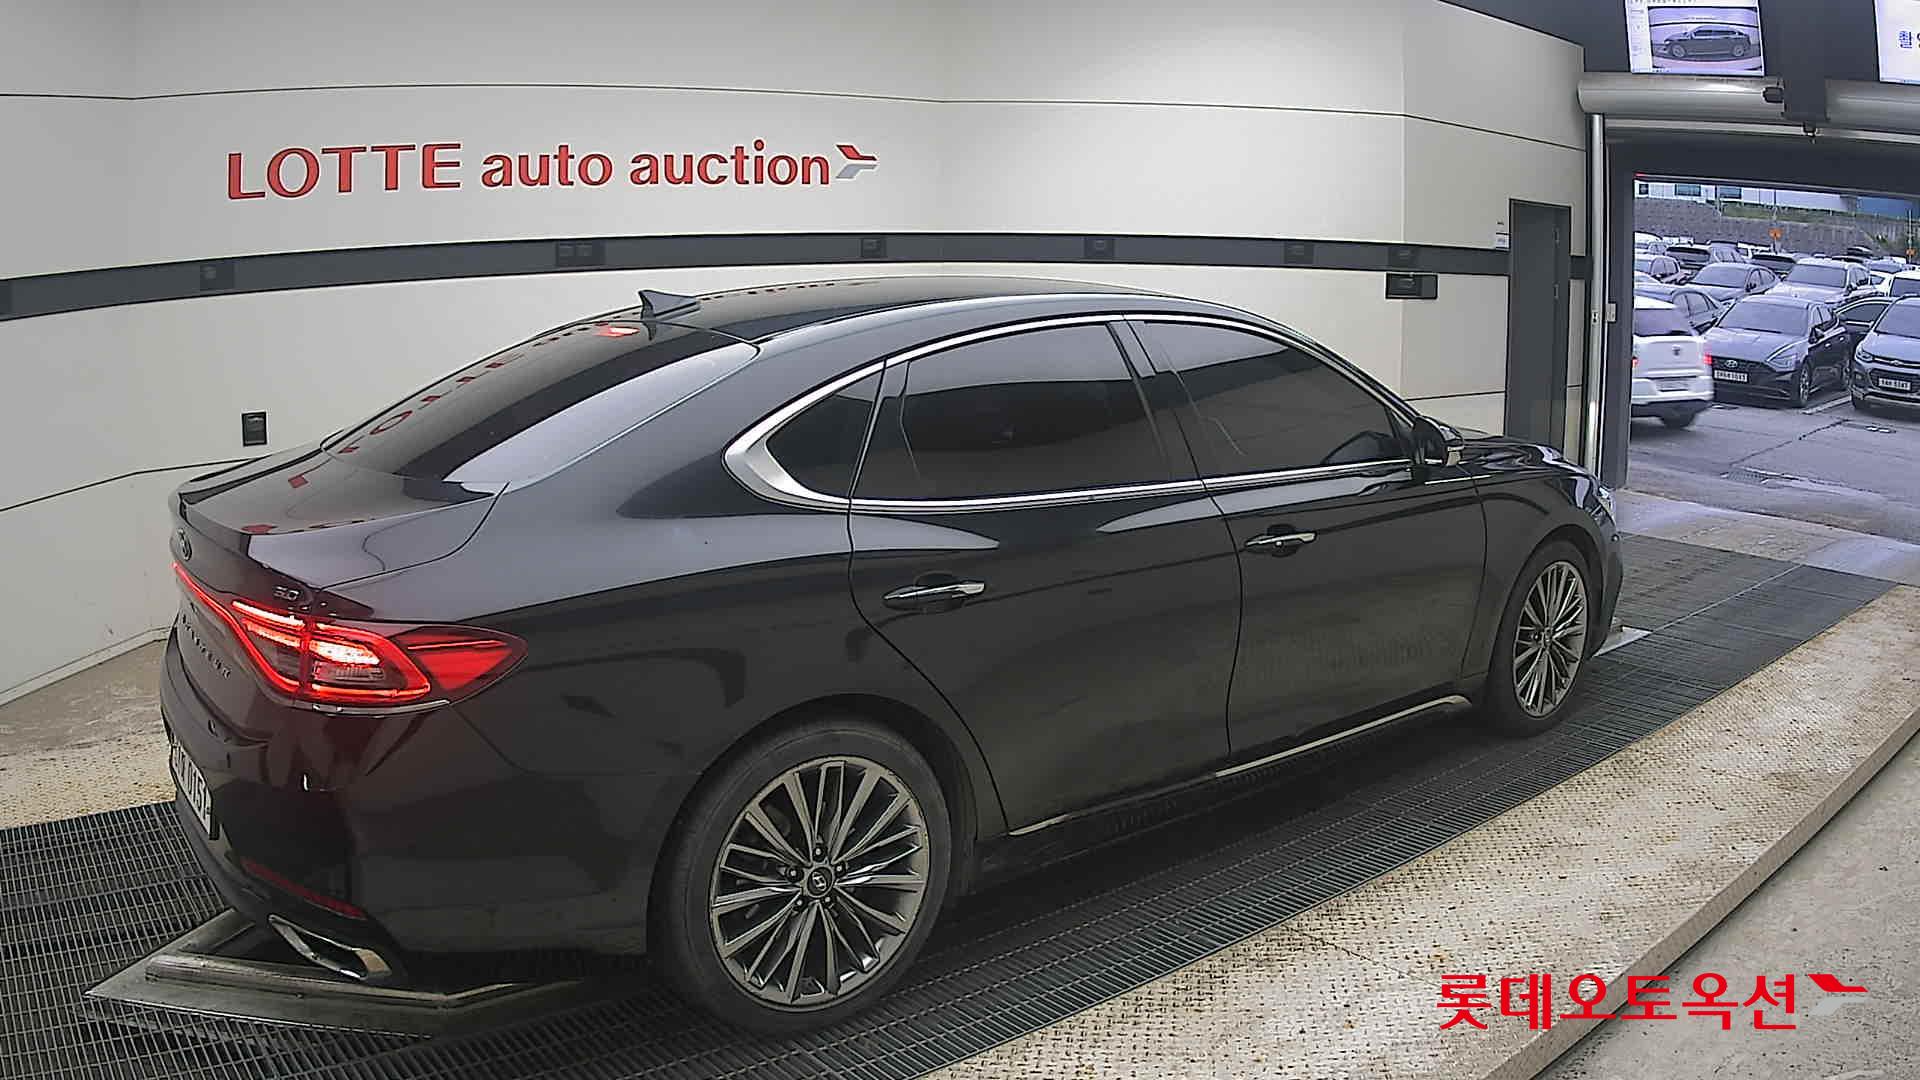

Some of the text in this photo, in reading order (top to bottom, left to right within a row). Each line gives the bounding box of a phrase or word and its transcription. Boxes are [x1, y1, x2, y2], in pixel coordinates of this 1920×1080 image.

[227, 138, 832, 201] LOTTE auto auction
